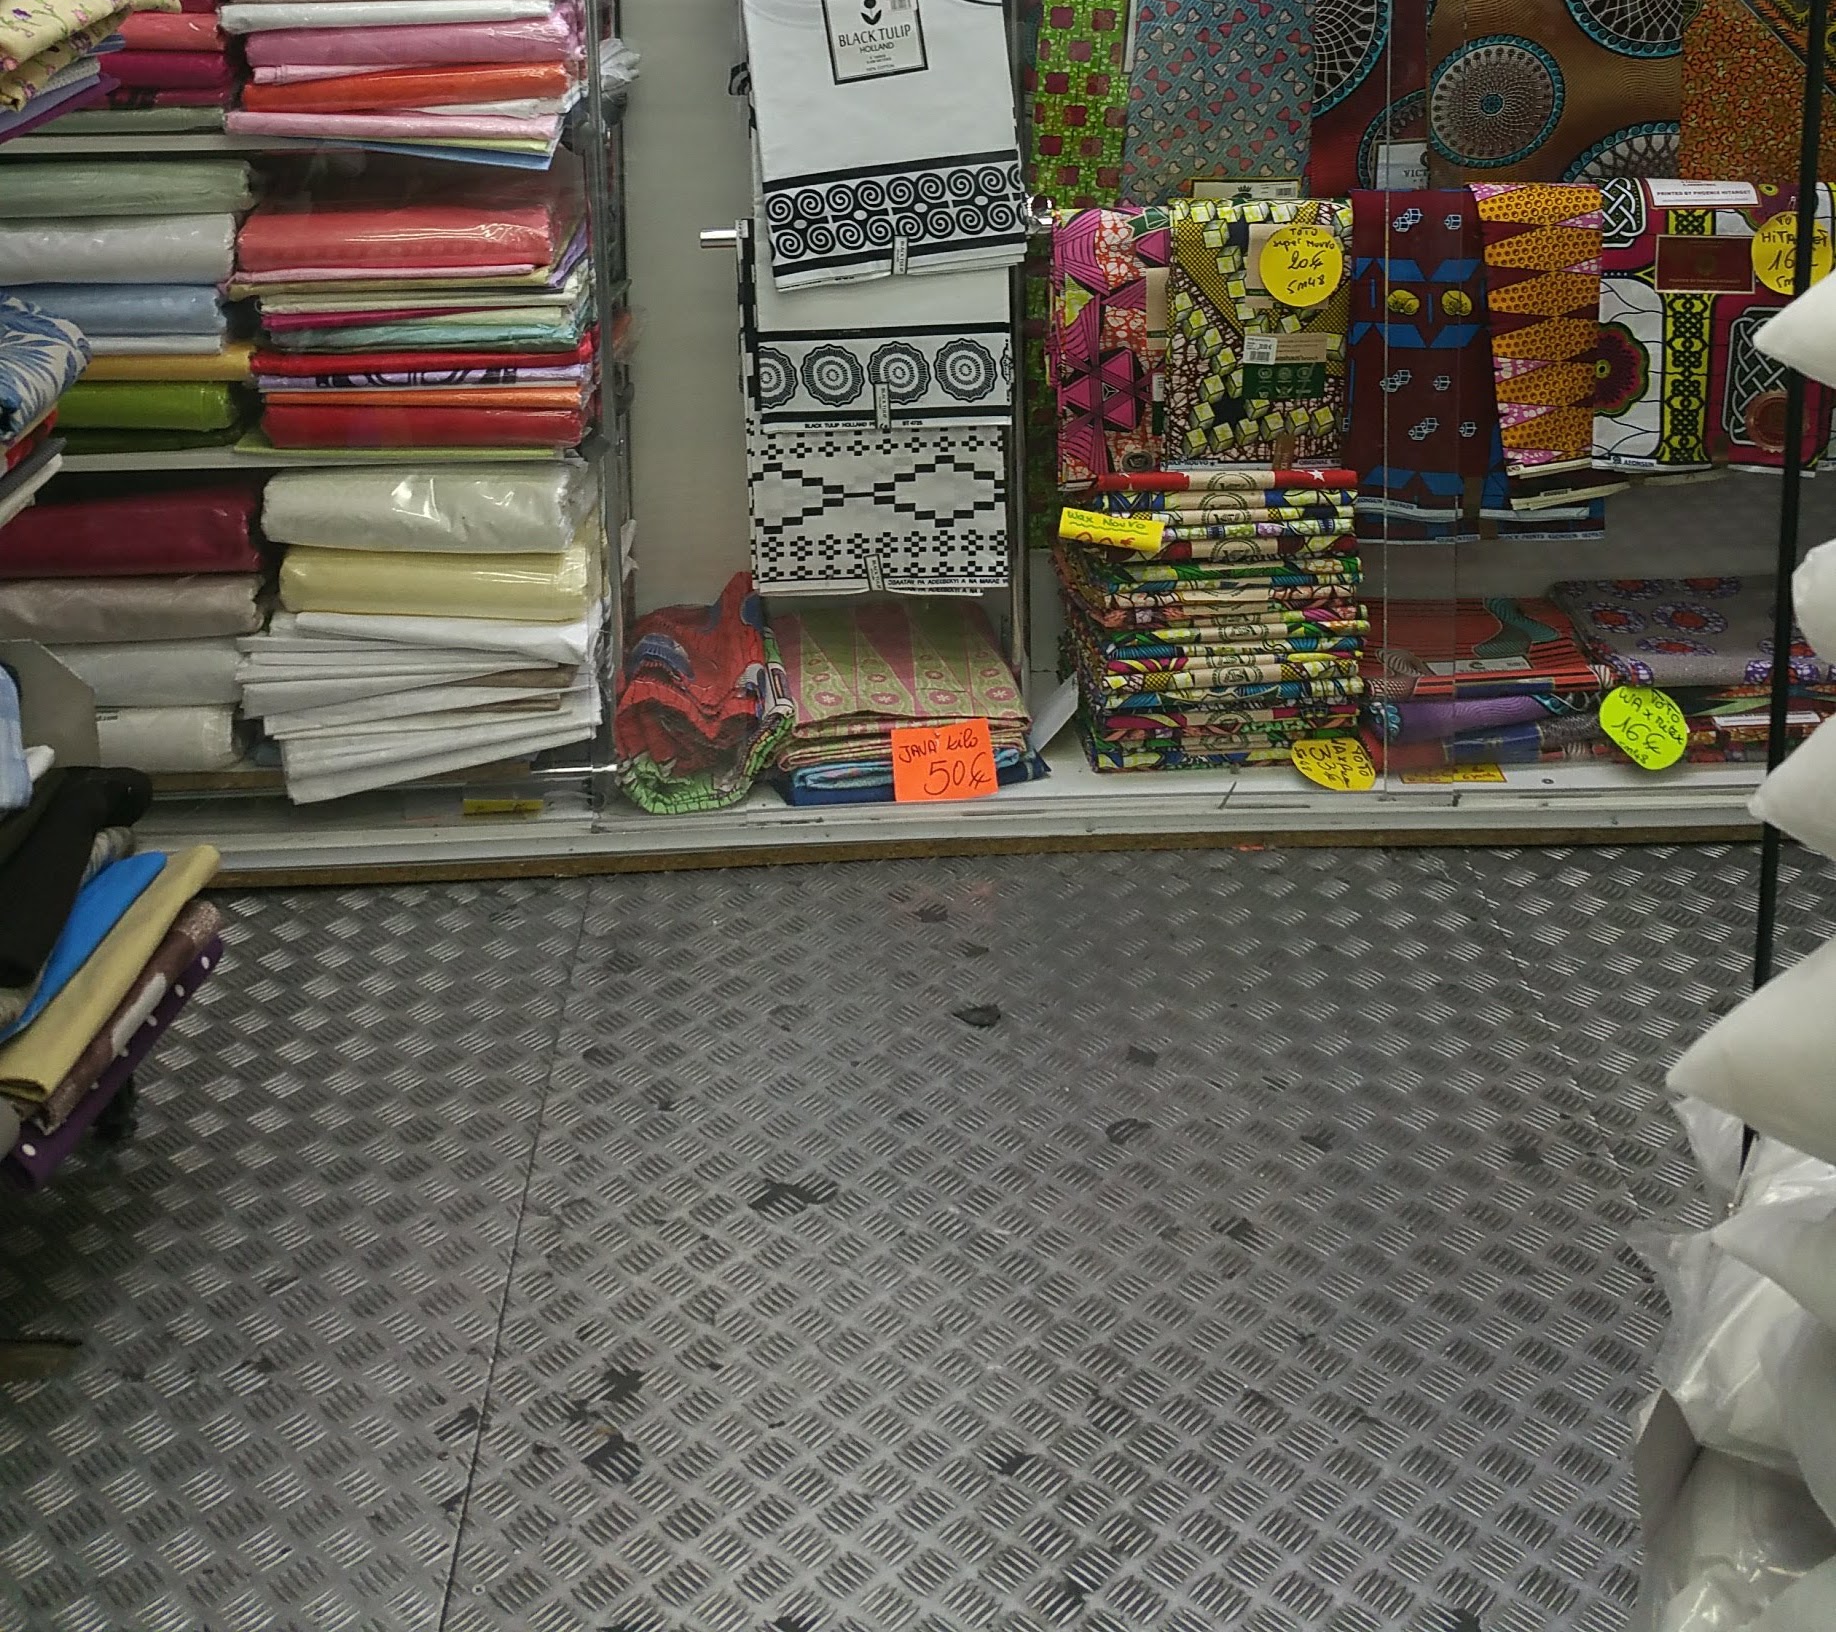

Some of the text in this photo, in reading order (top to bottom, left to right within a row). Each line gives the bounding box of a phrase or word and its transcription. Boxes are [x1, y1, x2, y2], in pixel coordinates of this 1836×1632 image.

[838, 23, 911, 48] BLACK TULIP
[859, 41, 895, 54] HOLLAND
[1286, 273, 1326, 295] 5m48
[1067, 510, 1095, 524] Wax
[1618, 688, 1654, 721] WAX
[1611, 716, 1666, 755] 16€
[898, 739, 937, 764] JAVA
[924, 751, 992, 796] 50€
